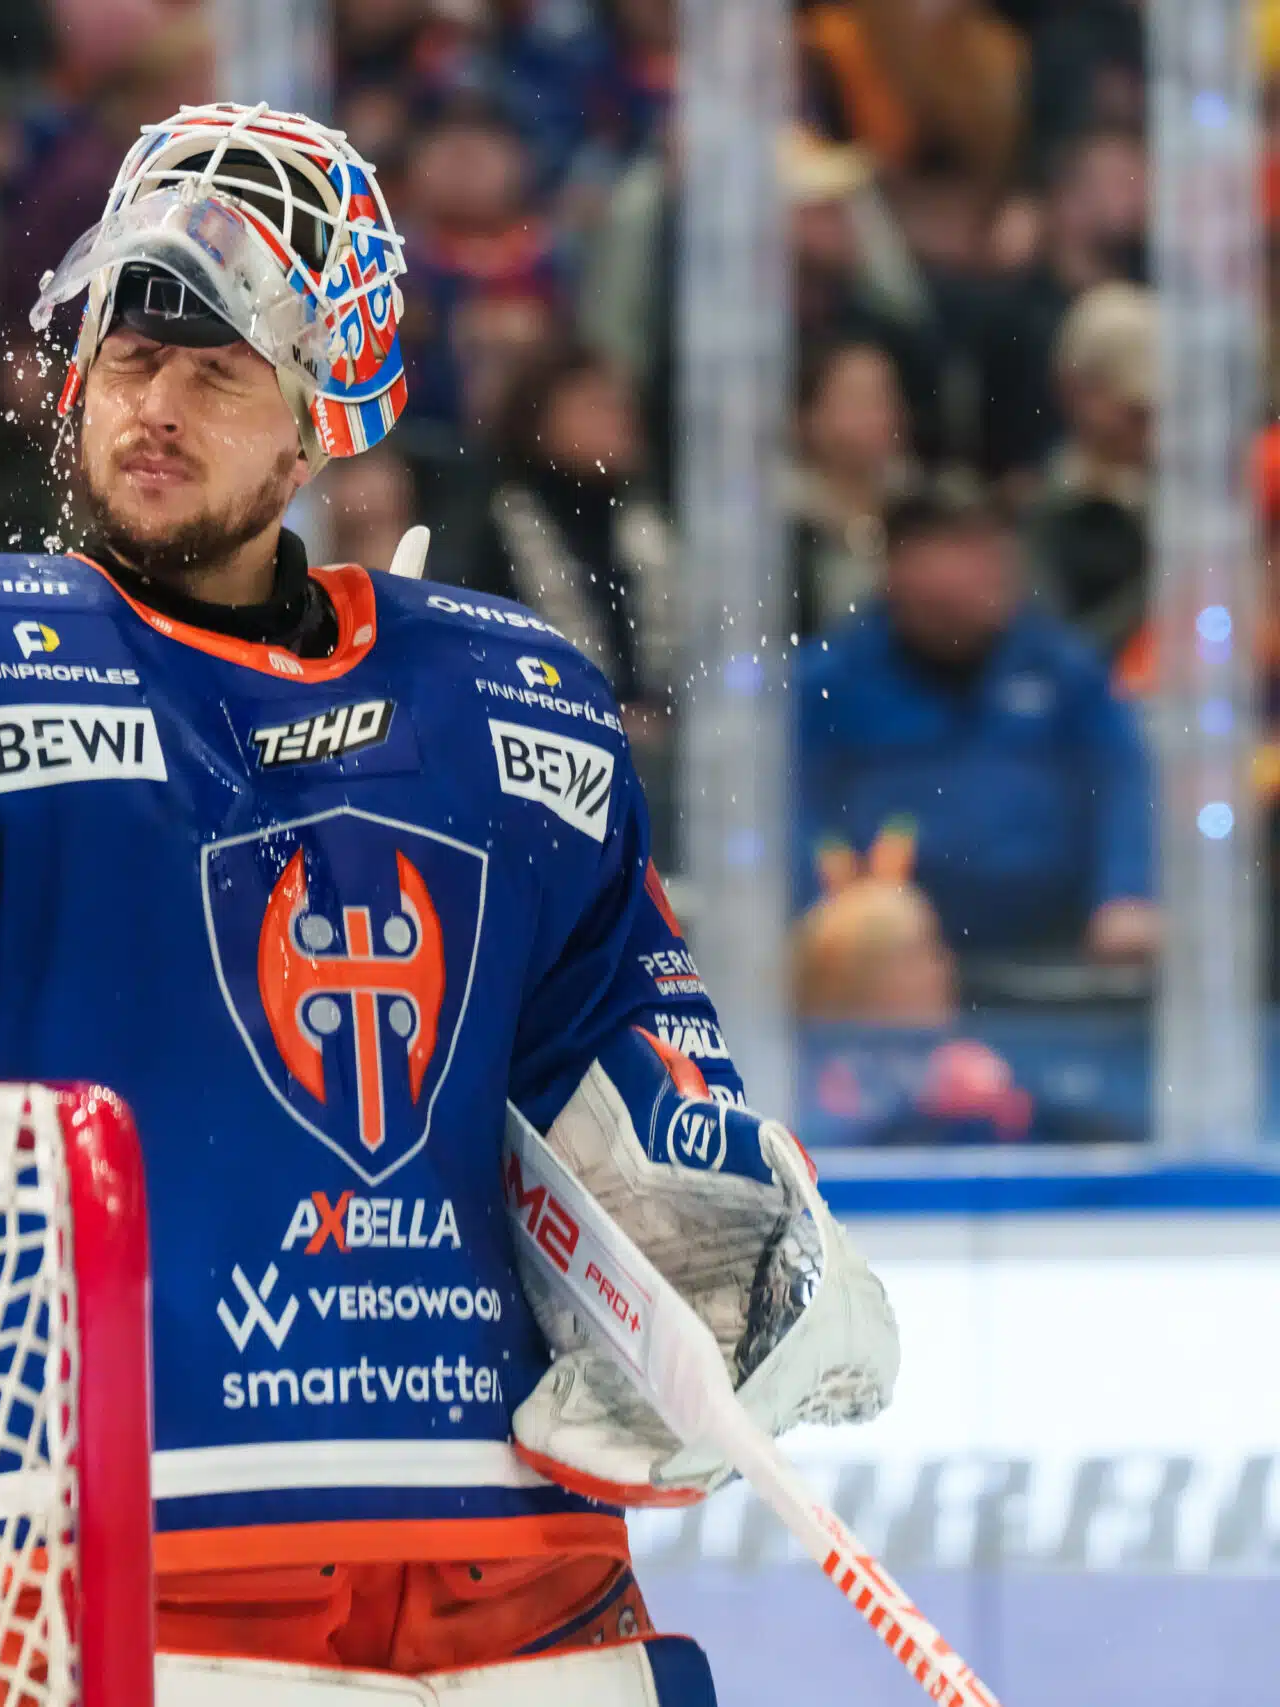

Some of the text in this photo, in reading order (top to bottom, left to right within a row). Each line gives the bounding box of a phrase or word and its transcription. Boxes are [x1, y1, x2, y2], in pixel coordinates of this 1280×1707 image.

[254, 700, 386, 765] TEHO
[280, 1190, 462, 1256] AXBELLA
[308, 1285, 502, 1322] VERSOWOOD
[584, 1260, 641, 1334] PRO+
